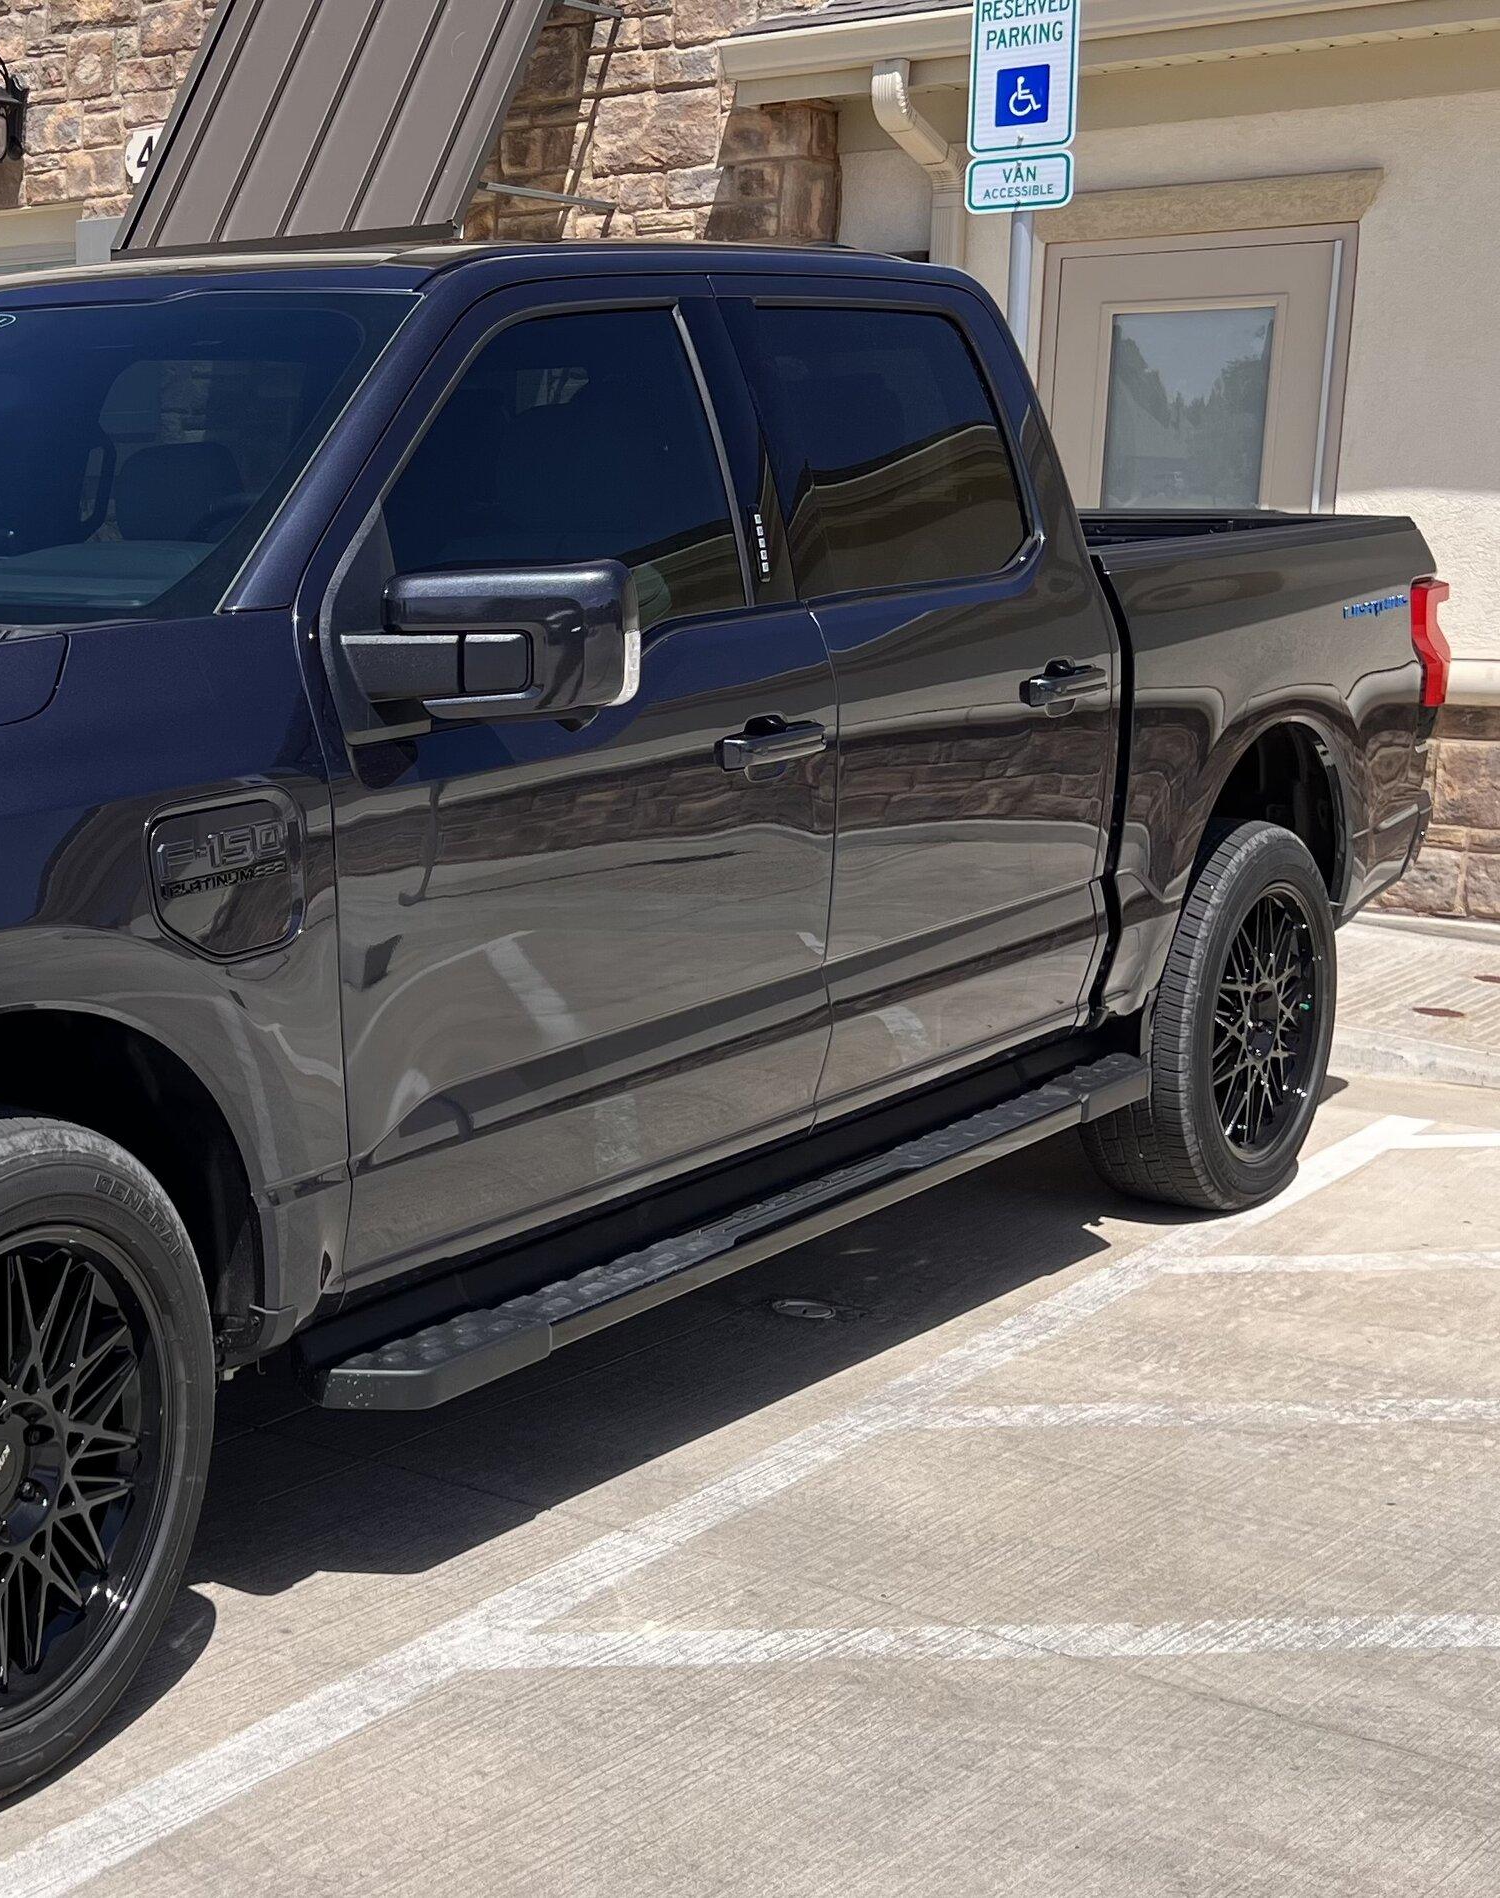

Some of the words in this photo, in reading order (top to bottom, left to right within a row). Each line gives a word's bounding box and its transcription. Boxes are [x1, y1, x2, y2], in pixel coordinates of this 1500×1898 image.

[981, 0, 1070, 22] RESERVED
[985, 20, 1064, 50] PARKING
[1002, 166, 1037, 183] VAN
[982, 184, 1054, 200] ACCESSIBLE
[156, 818, 287, 880] F-150
[168, 866, 256, 899] PLATINUM
[95, 1173, 182, 1270] GENERAL
